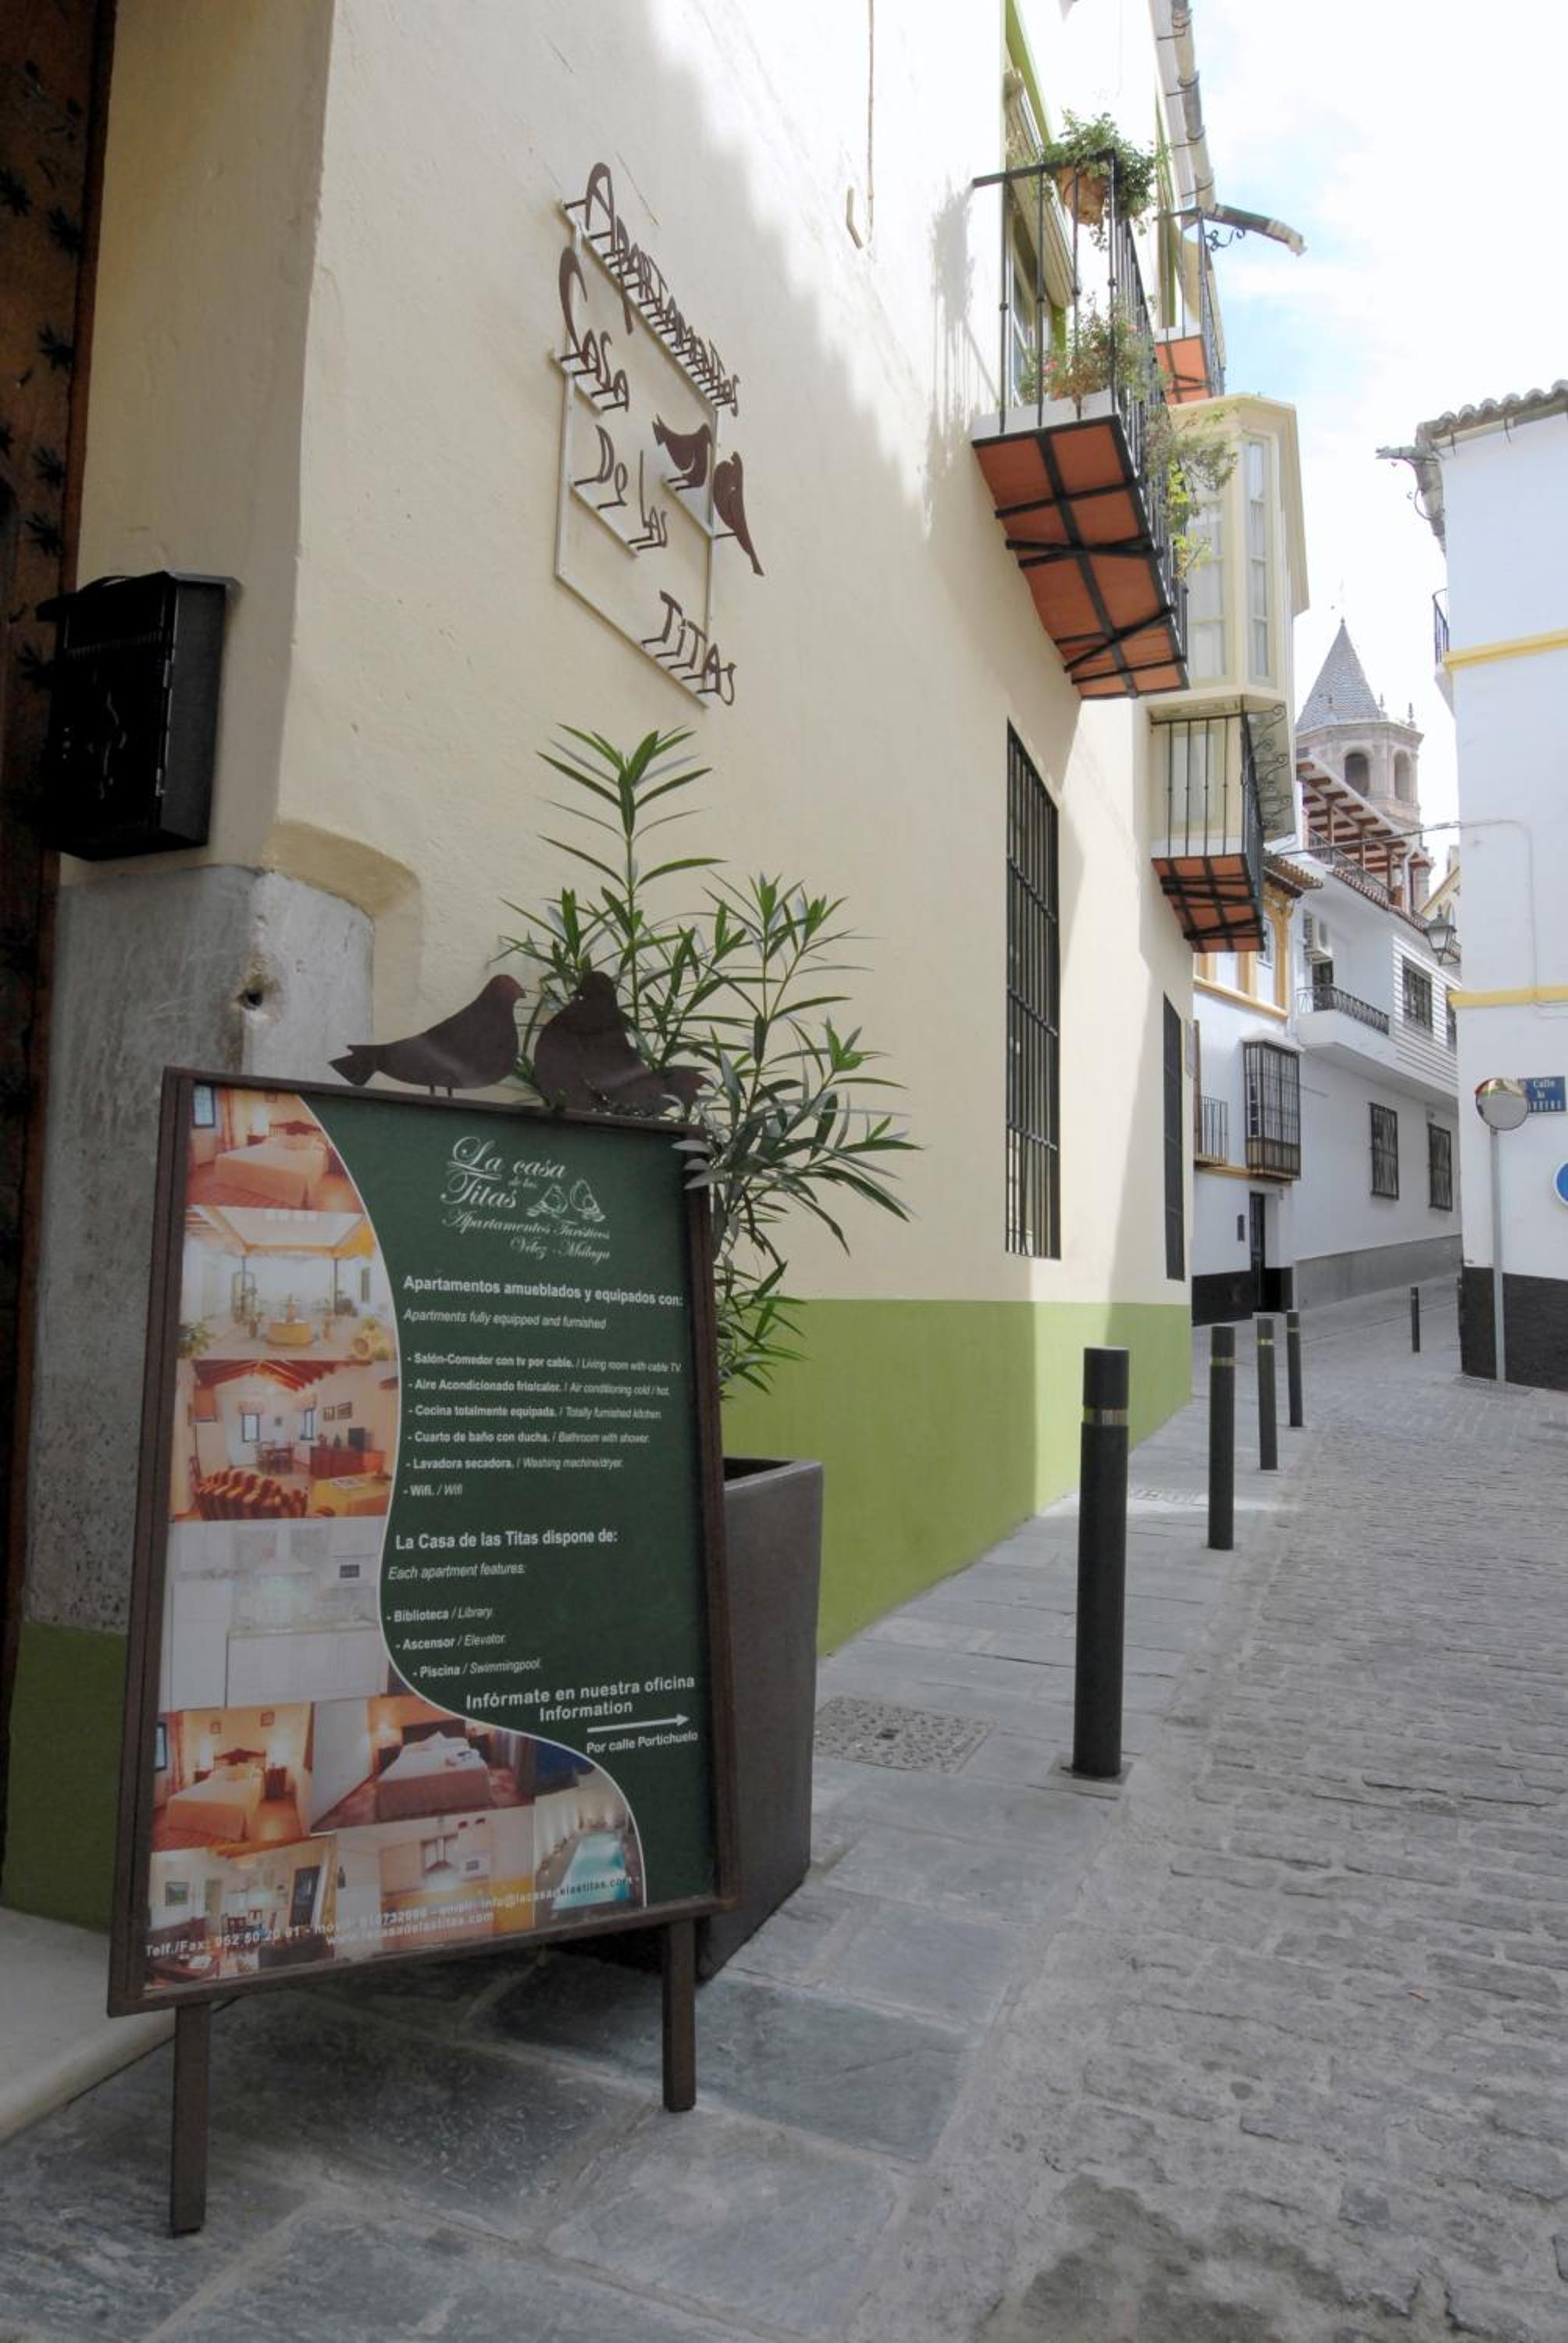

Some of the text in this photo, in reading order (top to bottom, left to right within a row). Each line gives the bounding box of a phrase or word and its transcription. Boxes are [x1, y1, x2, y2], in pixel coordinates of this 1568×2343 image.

[447, 1136, 565, 1178] La casa
[440, 1170, 518, 1208] Titas
[442, 1208, 551, 1235] Apartamentos
[403, 1275, 500, 1293] Apartamentos
[504, 1282, 582, 1300] amueblados
[585, 1289, 592, 1303] y
[594, 1289, 656, 1306] equipados
[403, 1308, 607, 1329] Apartments fully equipped and furnished
[495, 1356, 515, 1365] con
[528, 1357, 544, 1369] por
[582, 1358, 607, 1371] Living
[608, 1361, 629, 1371] room
[630, 1361, 647, 1371] with
[647, 1362, 669, 1372] cable
[414, 1378, 437, 1391] Aire
[439, 1378, 515, 1391] Acondicionado
[570, 1382, 582, 1393] Air
[633, 1384, 650, 1396] cold
[415, 1405, 452, 1417] Cocina
[454, 1406, 508, 1417] totalmente
[415, 1431, 451, 1443] Cuarto
[453, 1432, 466, 1443] de
[469, 1432, 494, 1443] baño
[496, 1433, 515, 1443] con
[558, 1432, 600, 1443] Bathroom
[413, 1458, 462, 1469] Lavadora
[396, 1534, 414, 1550] La
[418, 1532, 455, 1550] Casa
[458, 1532, 477, 1548] de
[480, 1531, 501, 1546] las
[504, 1530, 538, 1546] Titas
[542, 1528, 594, 1547] dispone
[387, 1566, 419, 1581] Each
[420, 1564, 478, 1582] apartment
[394, 1608, 449, 1622] Biblioteca
[403, 1637, 455, 1650] Ascensor
[419, 1665, 461, 1678] Piscina
[465, 1675, 696, 1710] Infórmate en nuestra oficina
[540, 1700, 633, 1723] Information
[586, 1730, 699, 1754] Por calle Portichuelo
